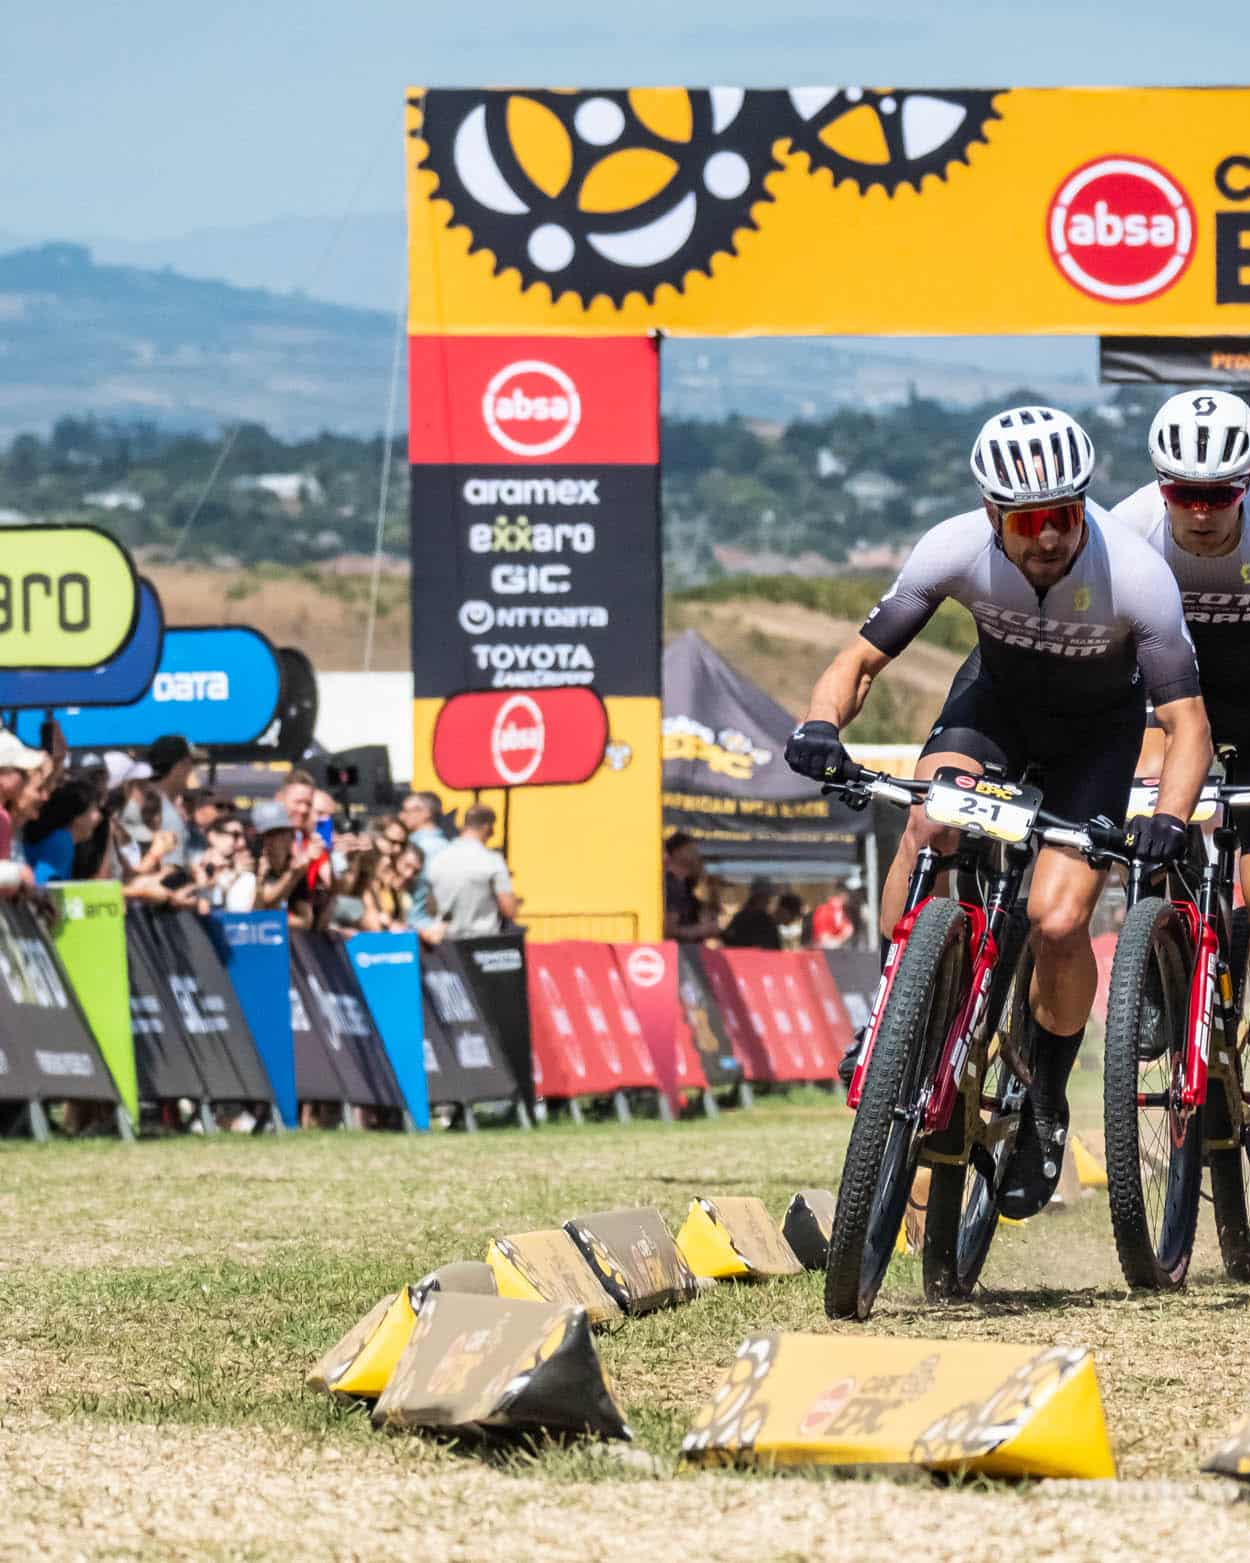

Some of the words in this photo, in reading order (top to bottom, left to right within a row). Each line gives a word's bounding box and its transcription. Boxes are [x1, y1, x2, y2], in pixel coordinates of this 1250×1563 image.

[1068, 201, 1176, 247] absa
[495, 387, 570, 421] absa
[463, 478, 600, 505] aramex
[469, 515, 596, 552] exxaro
[490, 564, 572, 594] GIC
[496, 607, 543, 627] NTT
[972, 600, 1108, 637] SCOTT
[472, 644, 594, 670] TOYOTA
[959, 796, 1002, 822] 2-1
